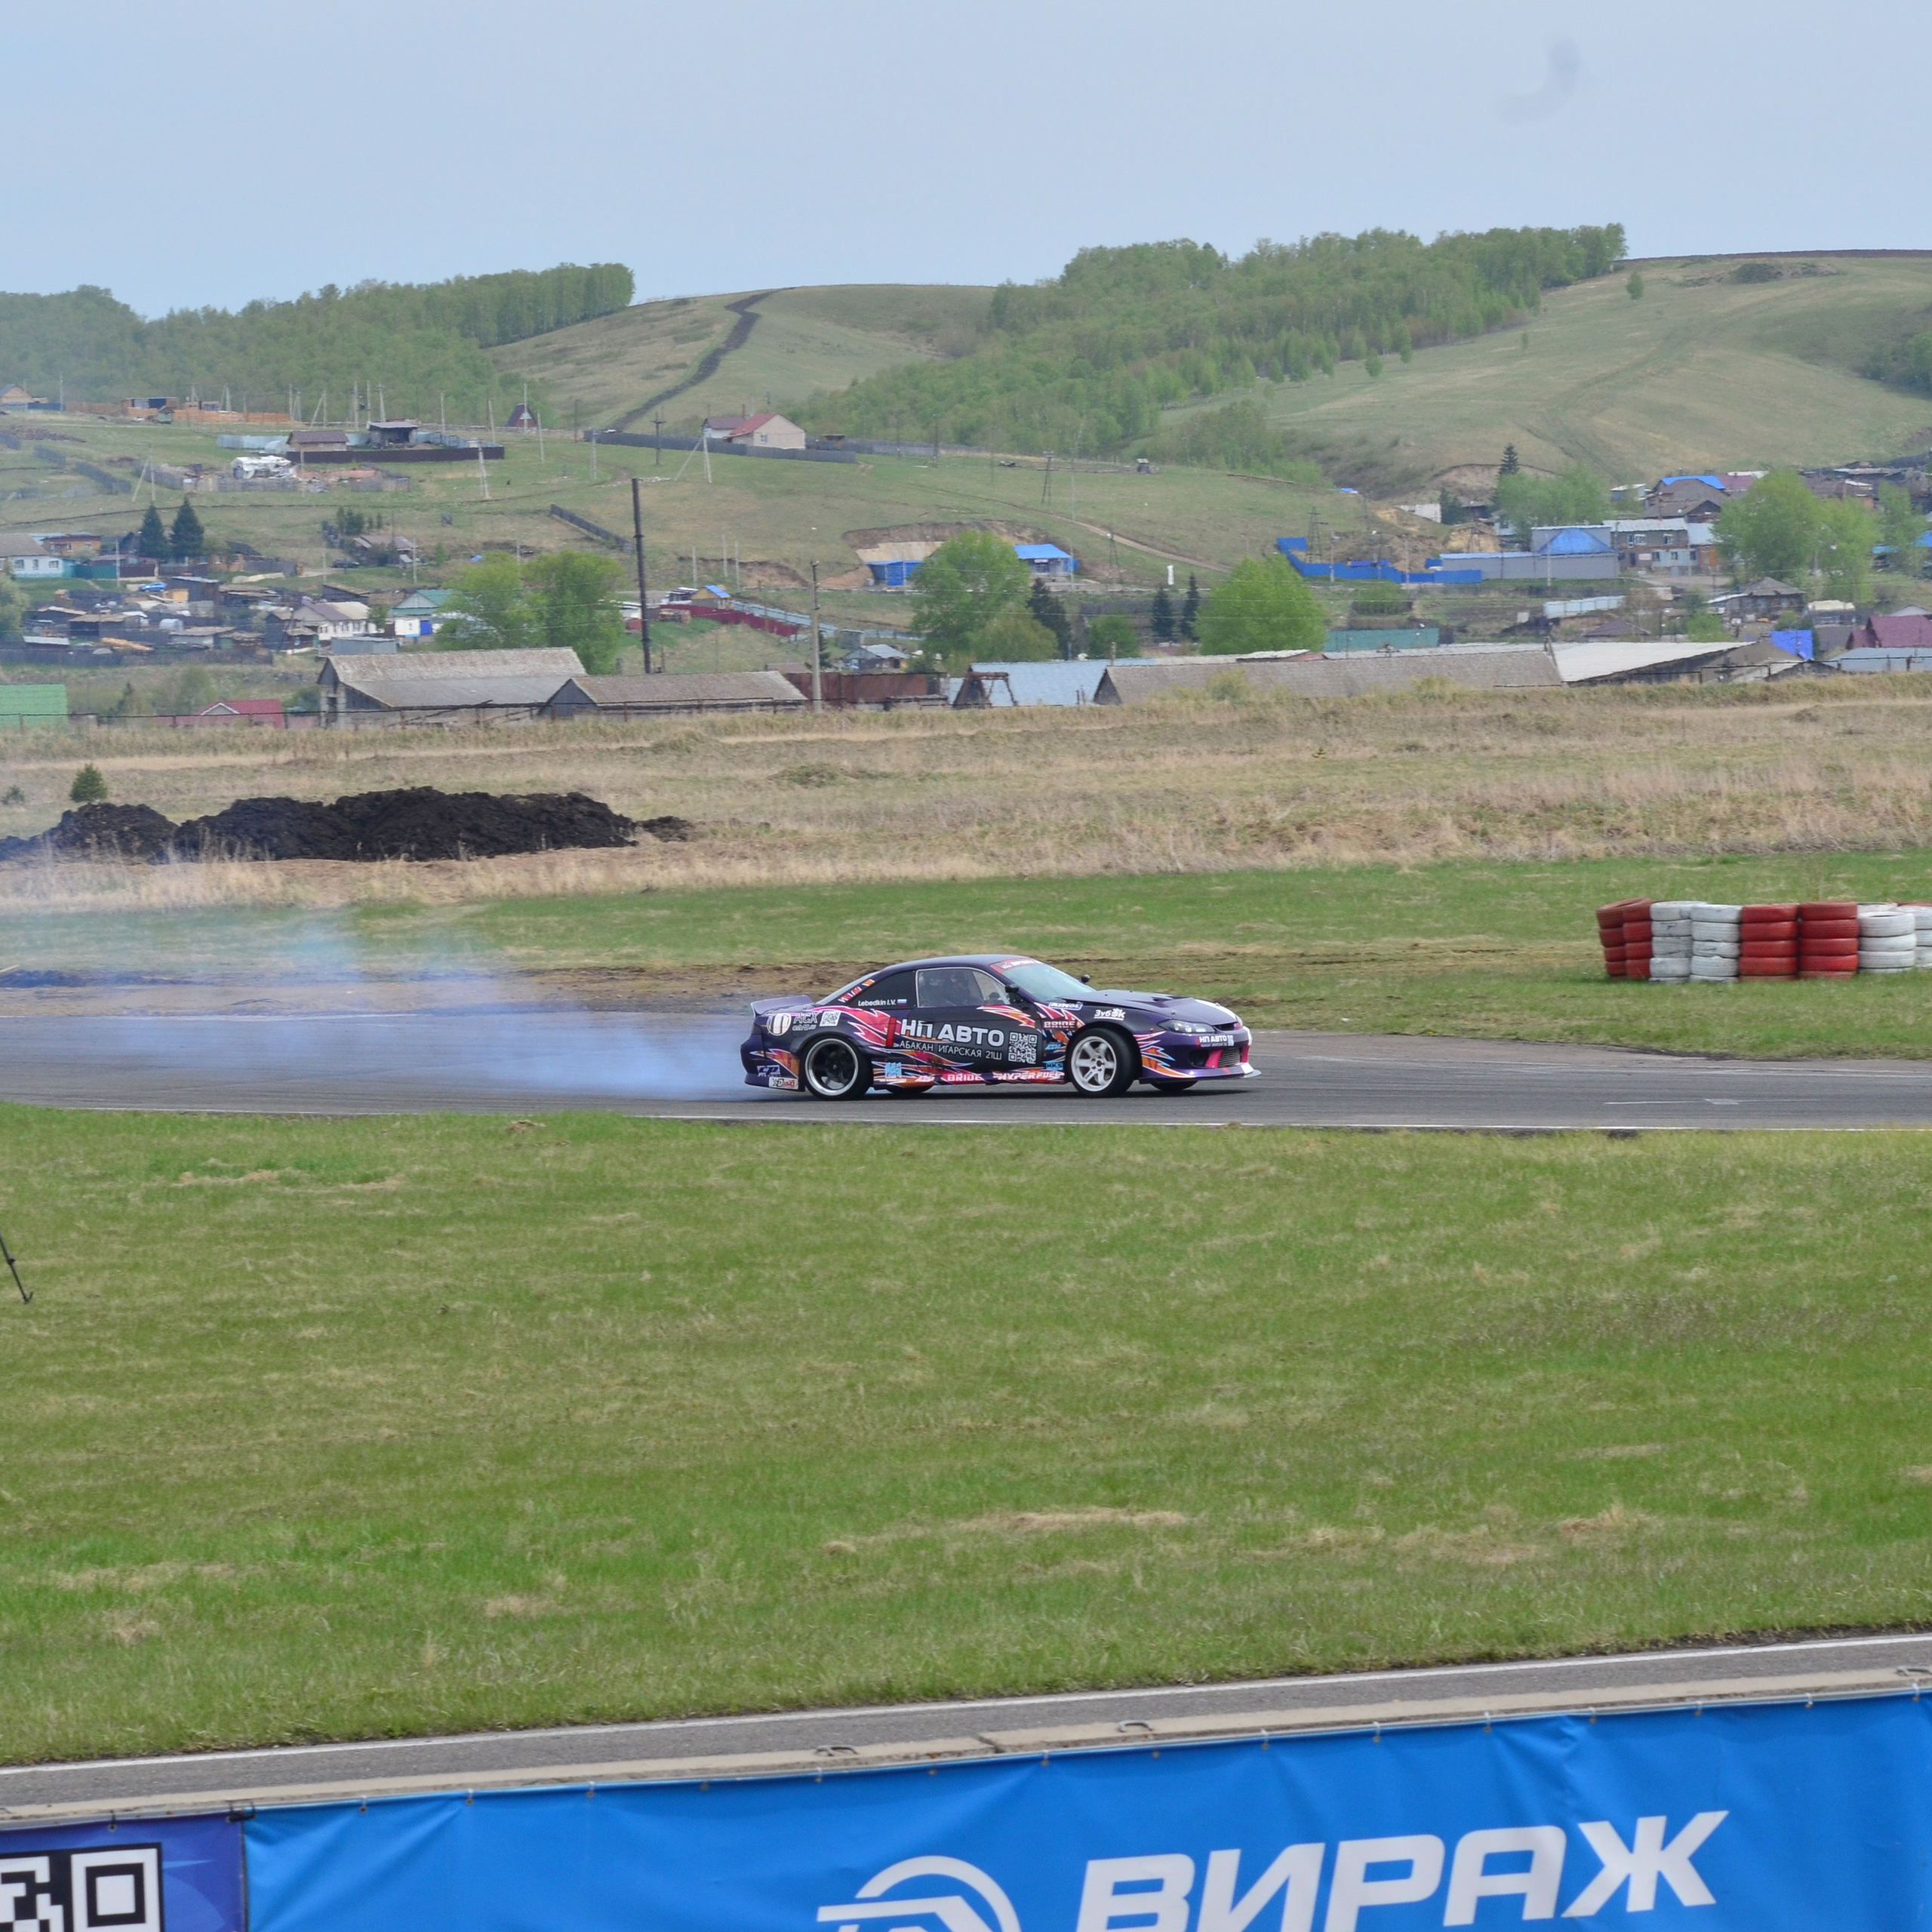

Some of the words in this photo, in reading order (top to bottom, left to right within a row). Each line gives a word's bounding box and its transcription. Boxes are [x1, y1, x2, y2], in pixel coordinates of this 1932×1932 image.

[900, 1019, 934, 1038] НП
[937, 1023, 1004, 1047] АВТО
[900, 1040, 934, 1052] АБАКАН
[938, 1044, 982, 1058] ИГАРСКАЯ
[947, 1073, 982, 1081] BRIDE
[1075, 1810, 1730, 1932] ВИРАЖ
